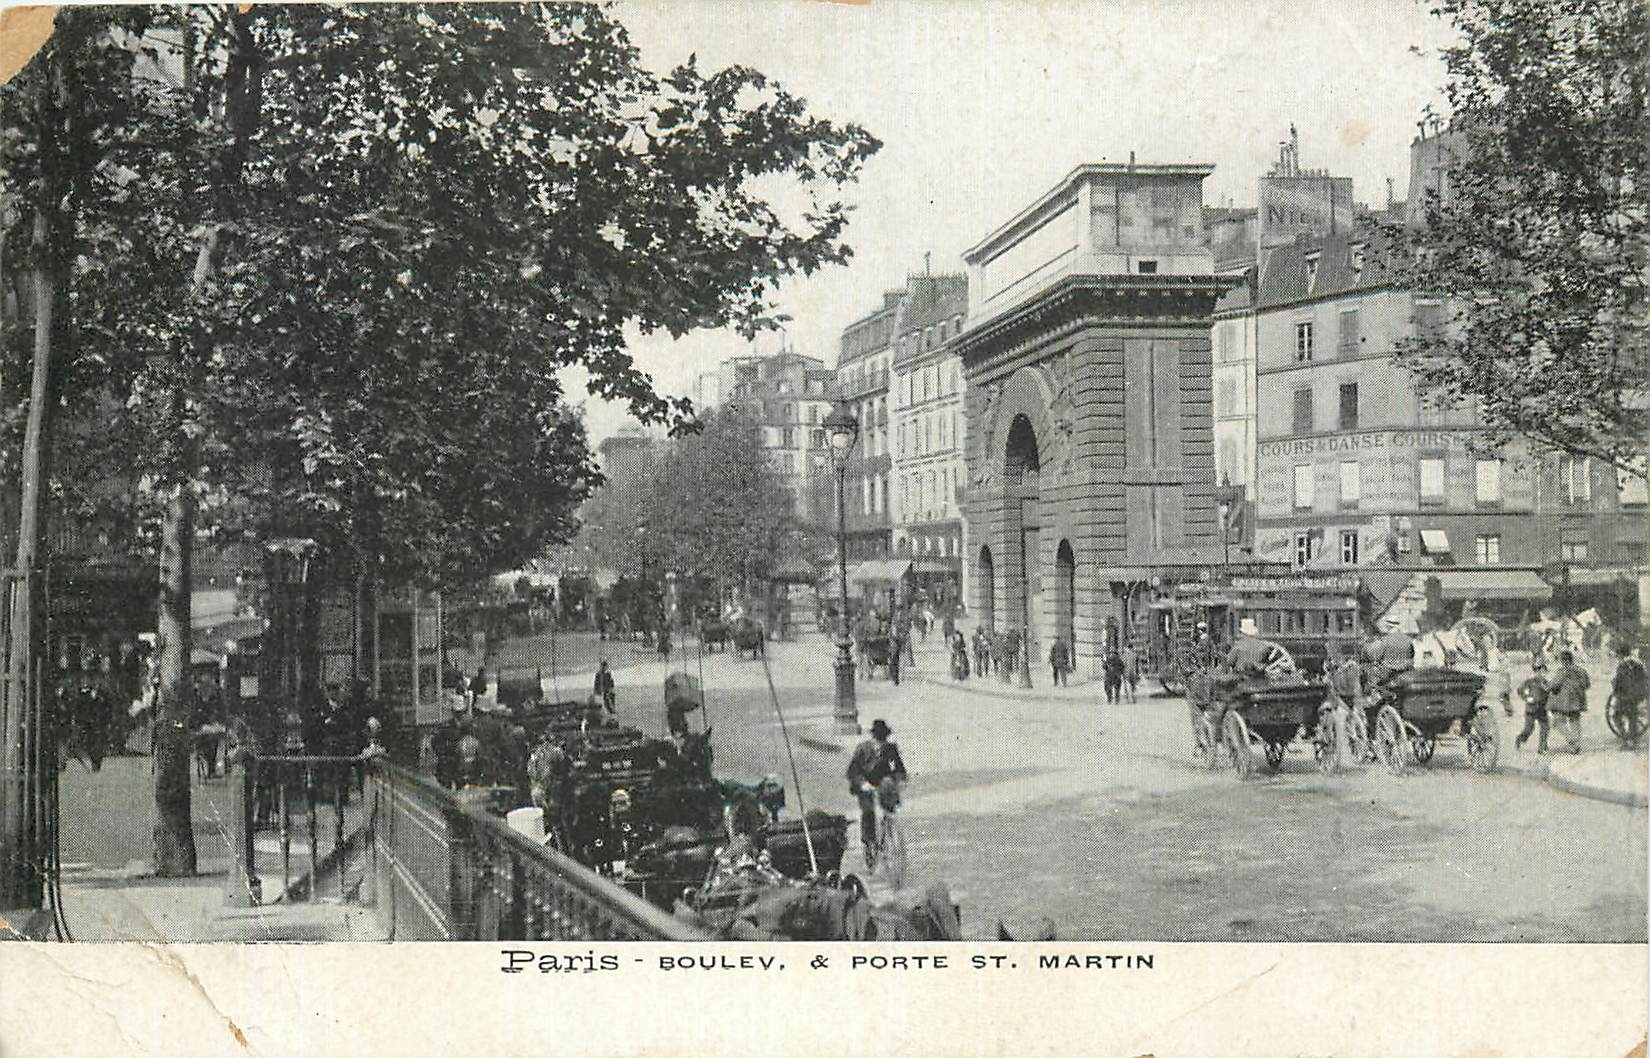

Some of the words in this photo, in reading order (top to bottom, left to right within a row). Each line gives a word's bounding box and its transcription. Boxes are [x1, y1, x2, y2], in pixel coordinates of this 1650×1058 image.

[1260, 440, 1314, 457] COURS
[1329, 434, 1384, 452] DANSE
[1393, 432, 1450, 447] COURS
